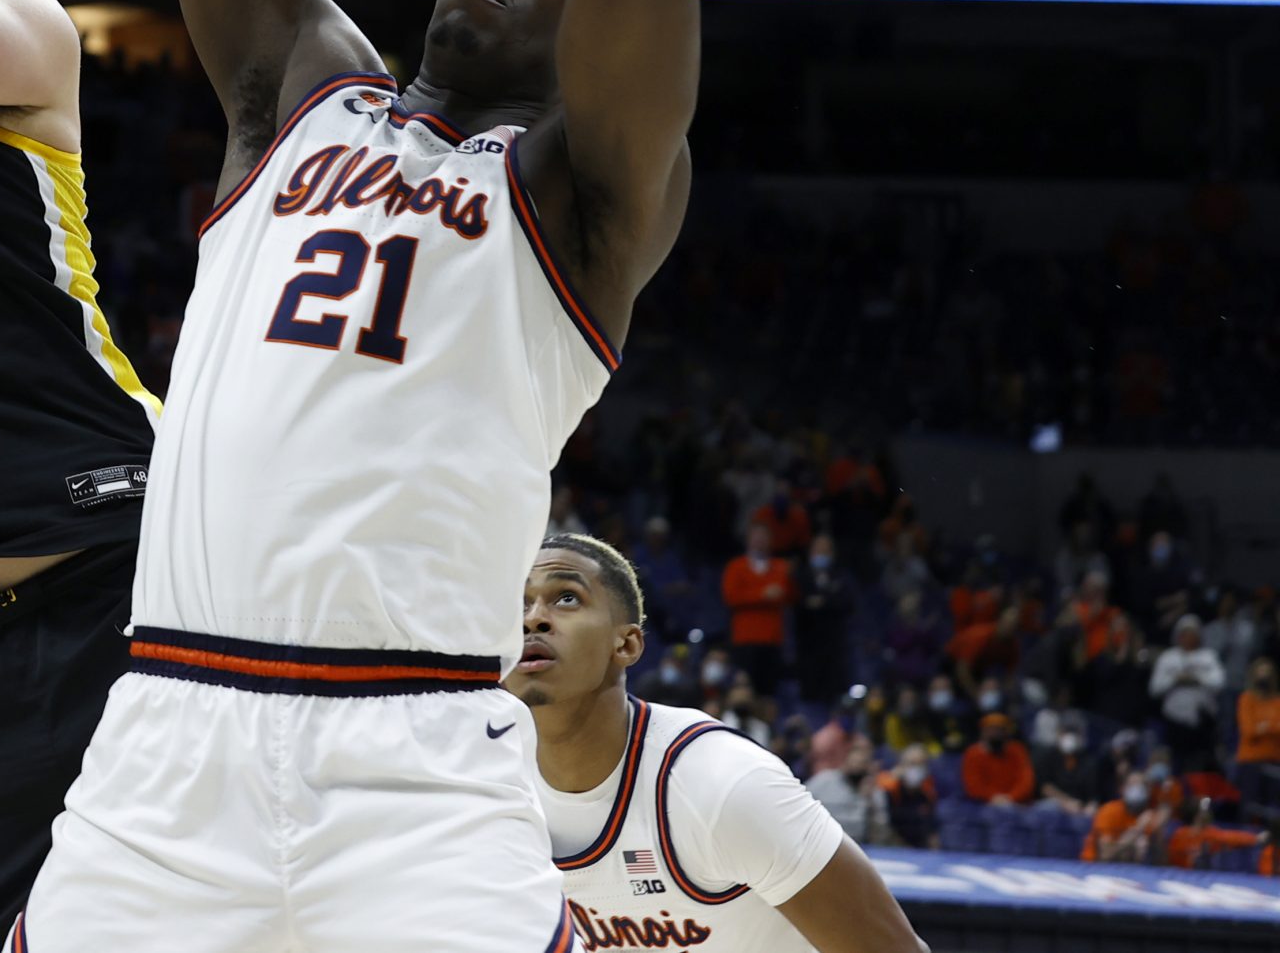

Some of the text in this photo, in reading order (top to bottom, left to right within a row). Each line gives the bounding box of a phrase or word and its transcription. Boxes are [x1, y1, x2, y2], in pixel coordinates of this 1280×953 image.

[264, 228, 419, 364] 21
[133, 471, 147, 482] 48
[73, 487, 94, 497] TEAM
